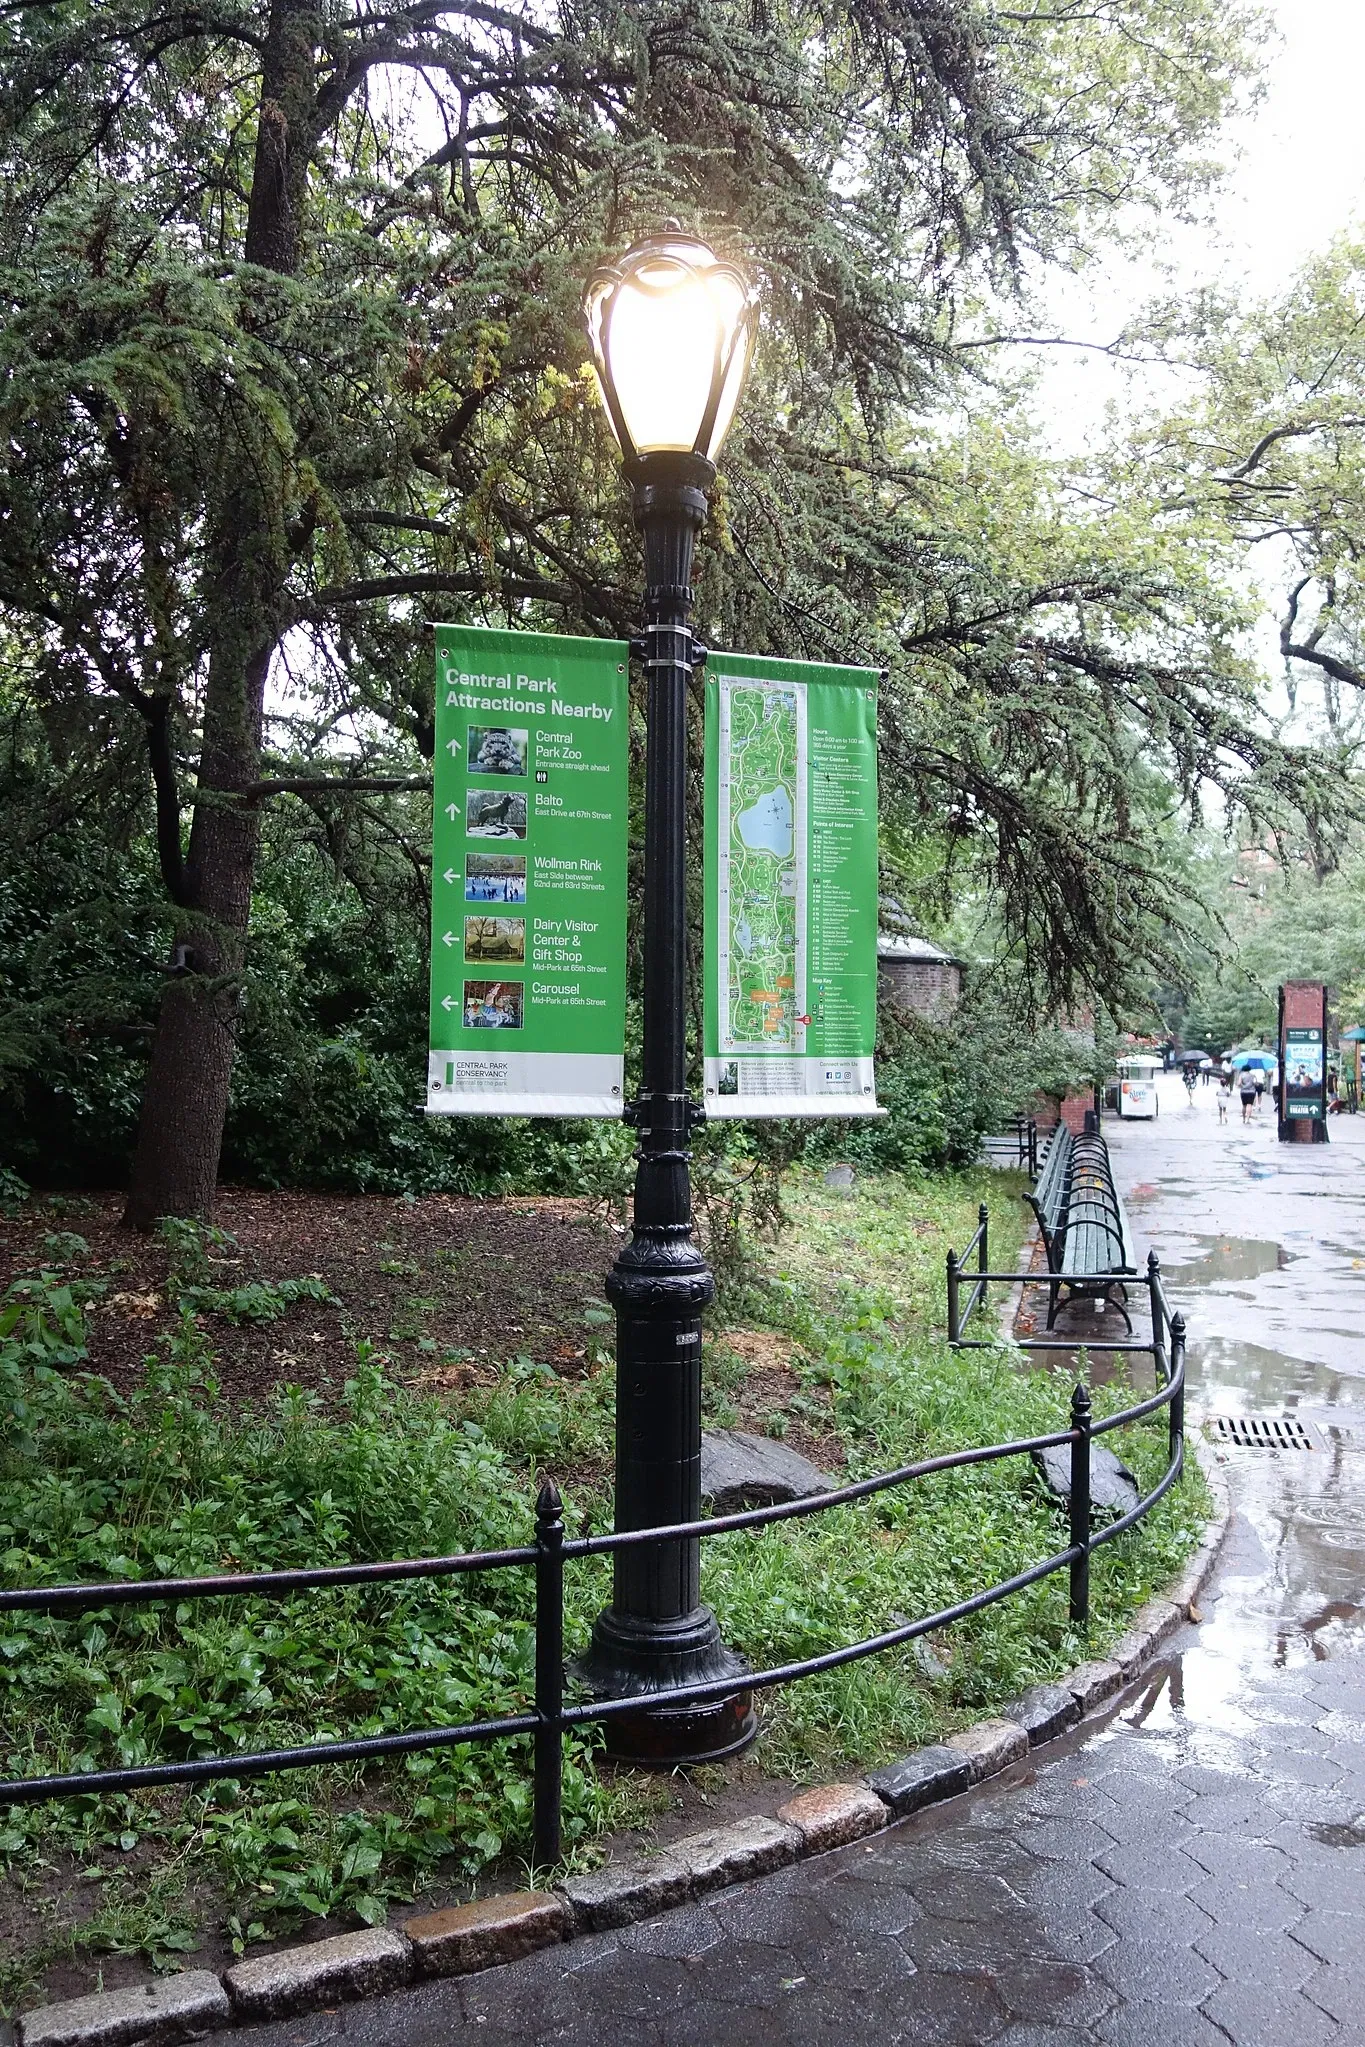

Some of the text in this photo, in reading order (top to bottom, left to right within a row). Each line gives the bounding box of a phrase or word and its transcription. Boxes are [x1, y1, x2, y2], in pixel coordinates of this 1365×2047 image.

[445, 669, 557, 693] Central Park
[445, 691, 612, 722] Attractions Nearby
[536, 731, 573, 744] Central
[536, 746, 582, 760] Park Zoo
[536, 760, 609, 772] Entrance straight ahead
[536, 794, 563, 806] Balto
[535, 808, 549, 816] East
[551, 809, 567, 817] Drive
[577, 810, 590, 818] 67th
[592, 811, 611, 819] Street
[535, 857, 602, 871] Wollman Rink
[534, 872, 593, 881] East Side between
[534, 880, 550, 888] 62nd
[565, 881, 580, 889] 63rd
[581, 882, 605, 890] Streets
[534, 919, 598, 932] Dairy Visitor
[533, 934, 581, 946] Center &
[533, 949, 582, 963] Gift Shop
[533, 964, 561, 972] Mid-Park
[571, 964, 585, 972] 65th
[587, 965, 607, 973] Street
[532, 982, 579, 994] Carousel
[532, 997, 560, 1005] Mid-Park
[569, 998, 584, 1006] 65th
[586, 998, 606, 1006] Street
